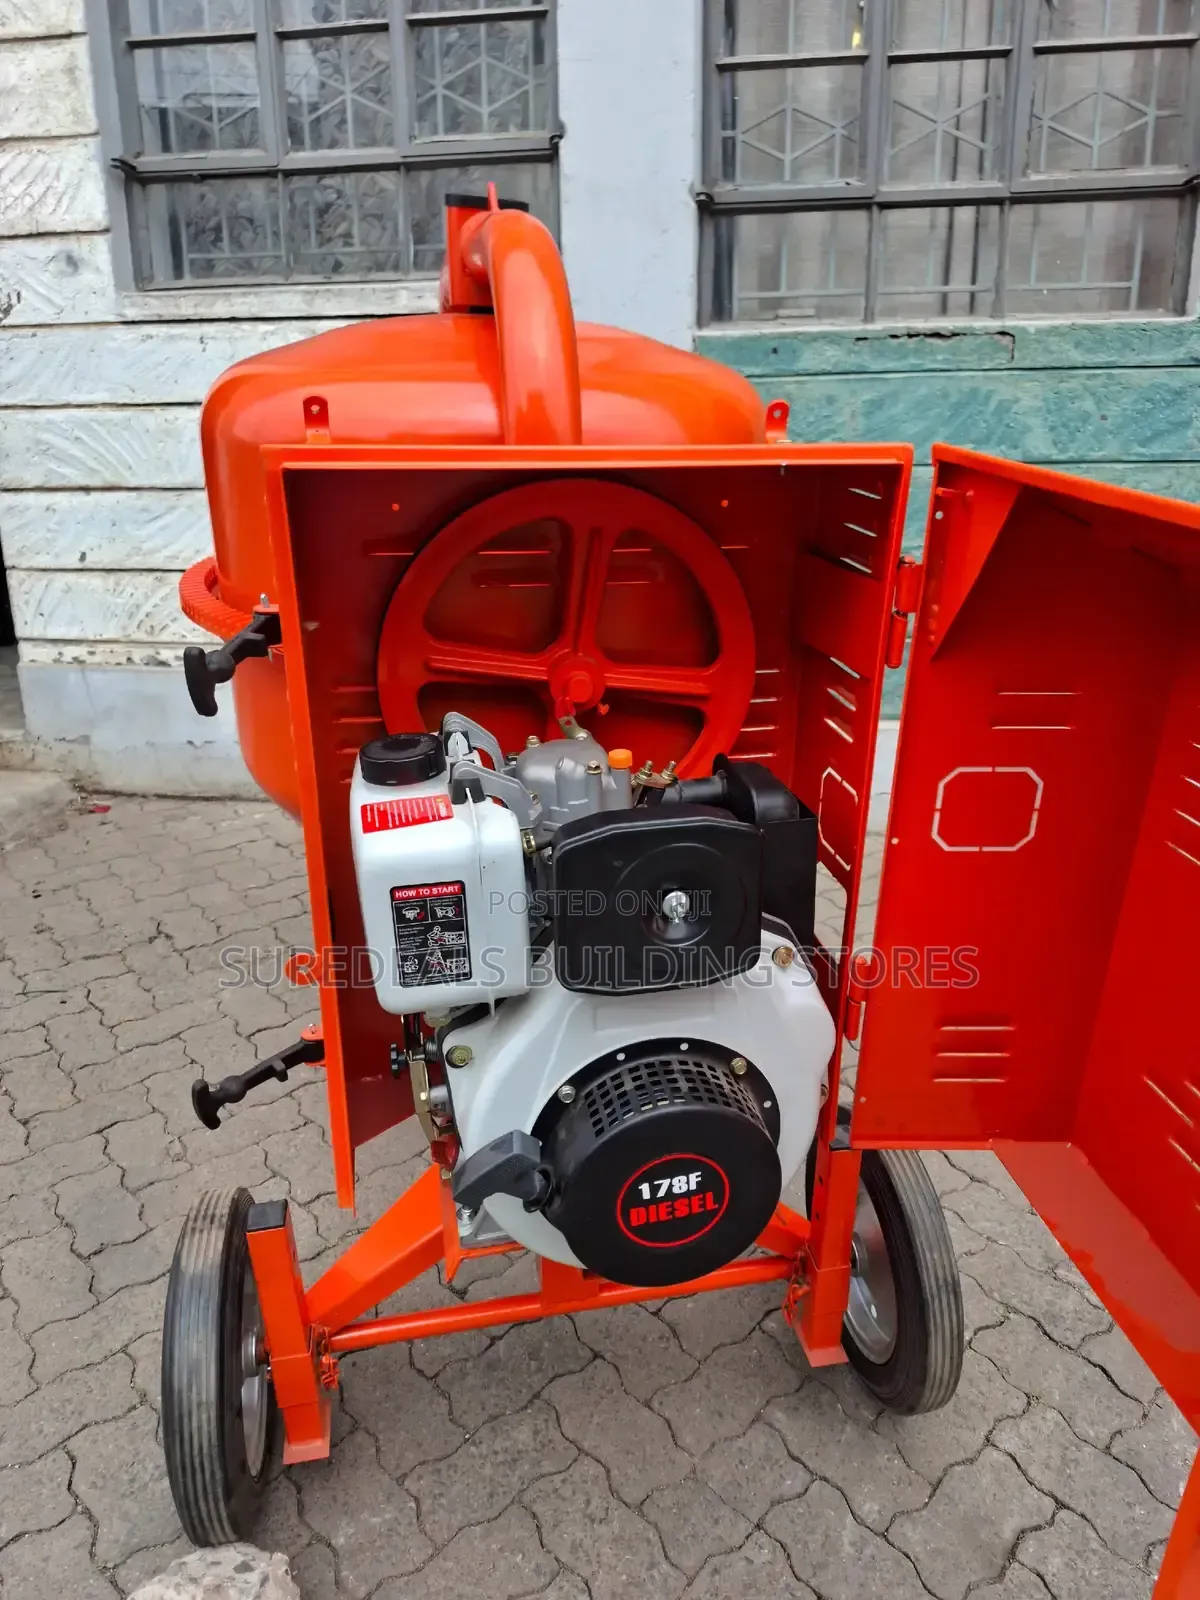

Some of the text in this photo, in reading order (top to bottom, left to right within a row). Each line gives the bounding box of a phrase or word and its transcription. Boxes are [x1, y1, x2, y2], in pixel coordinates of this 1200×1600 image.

[396, 890, 416, 898] HOW
[432, 885, 459, 894] START
[638, 1171, 702, 1200] 178F
[629, 1191, 718, 1227] DIESEL
